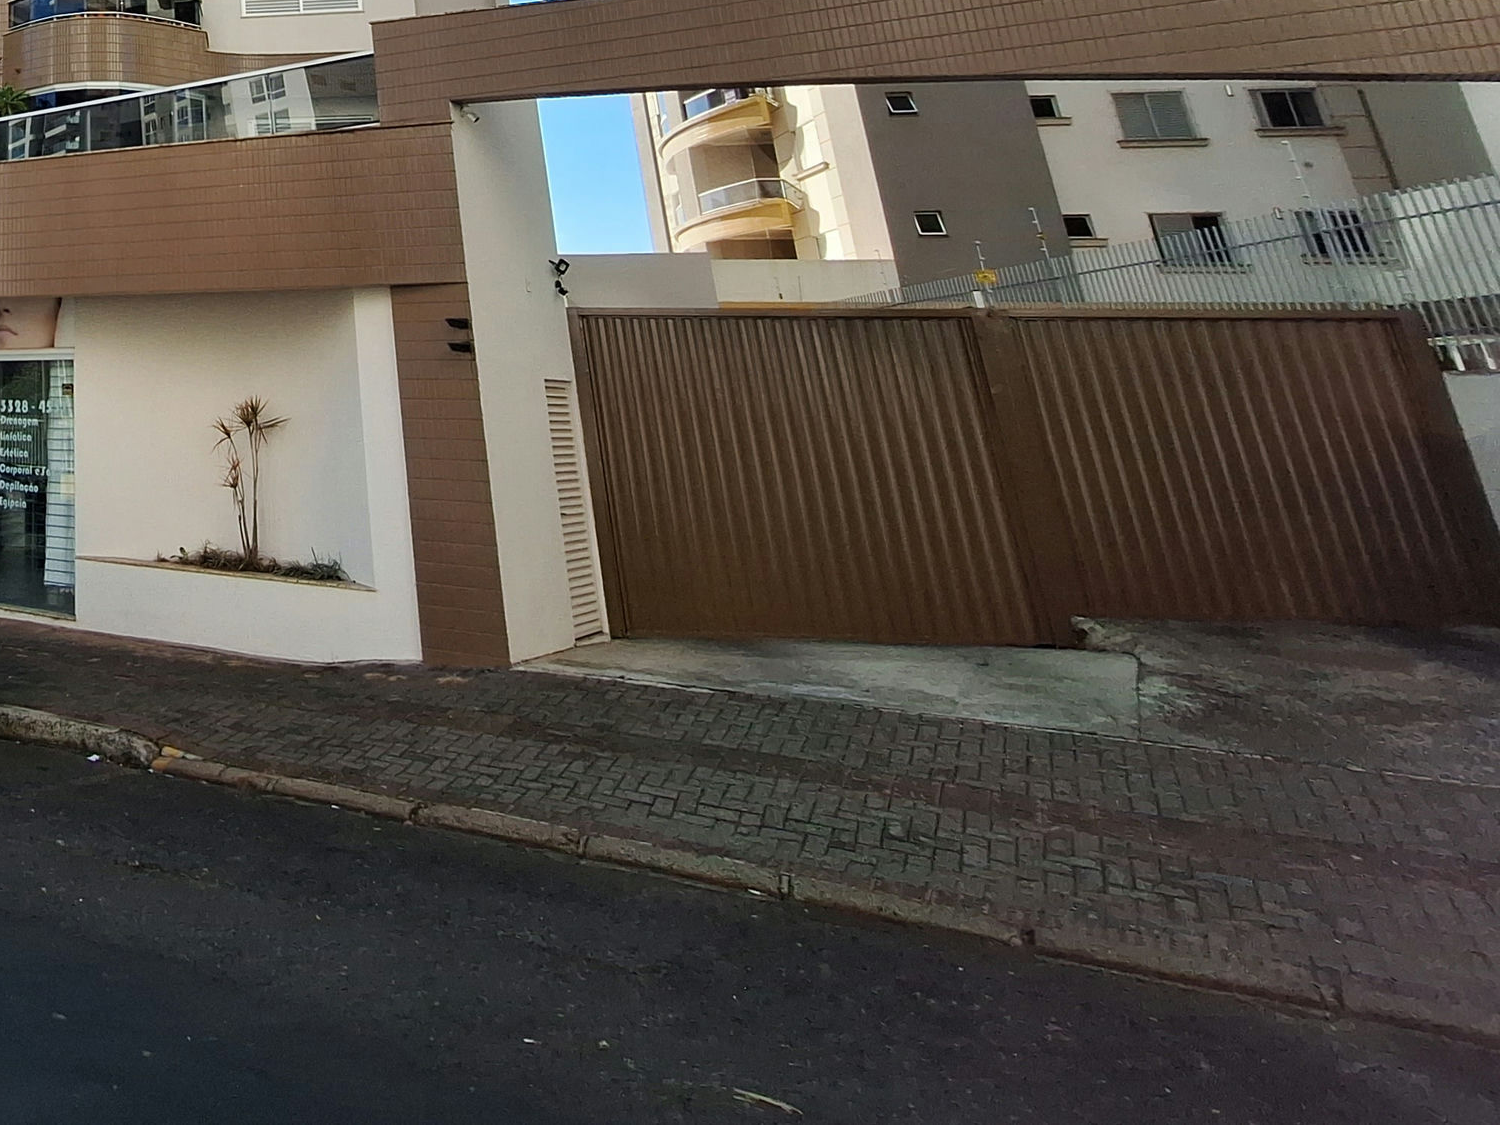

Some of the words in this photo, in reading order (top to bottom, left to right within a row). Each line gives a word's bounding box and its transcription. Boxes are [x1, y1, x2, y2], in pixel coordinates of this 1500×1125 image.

[0, 416, 39, 428] Drenagem
[0, 464, 33, 476] Corporal
[0, 480, 39, 493] Depilação
